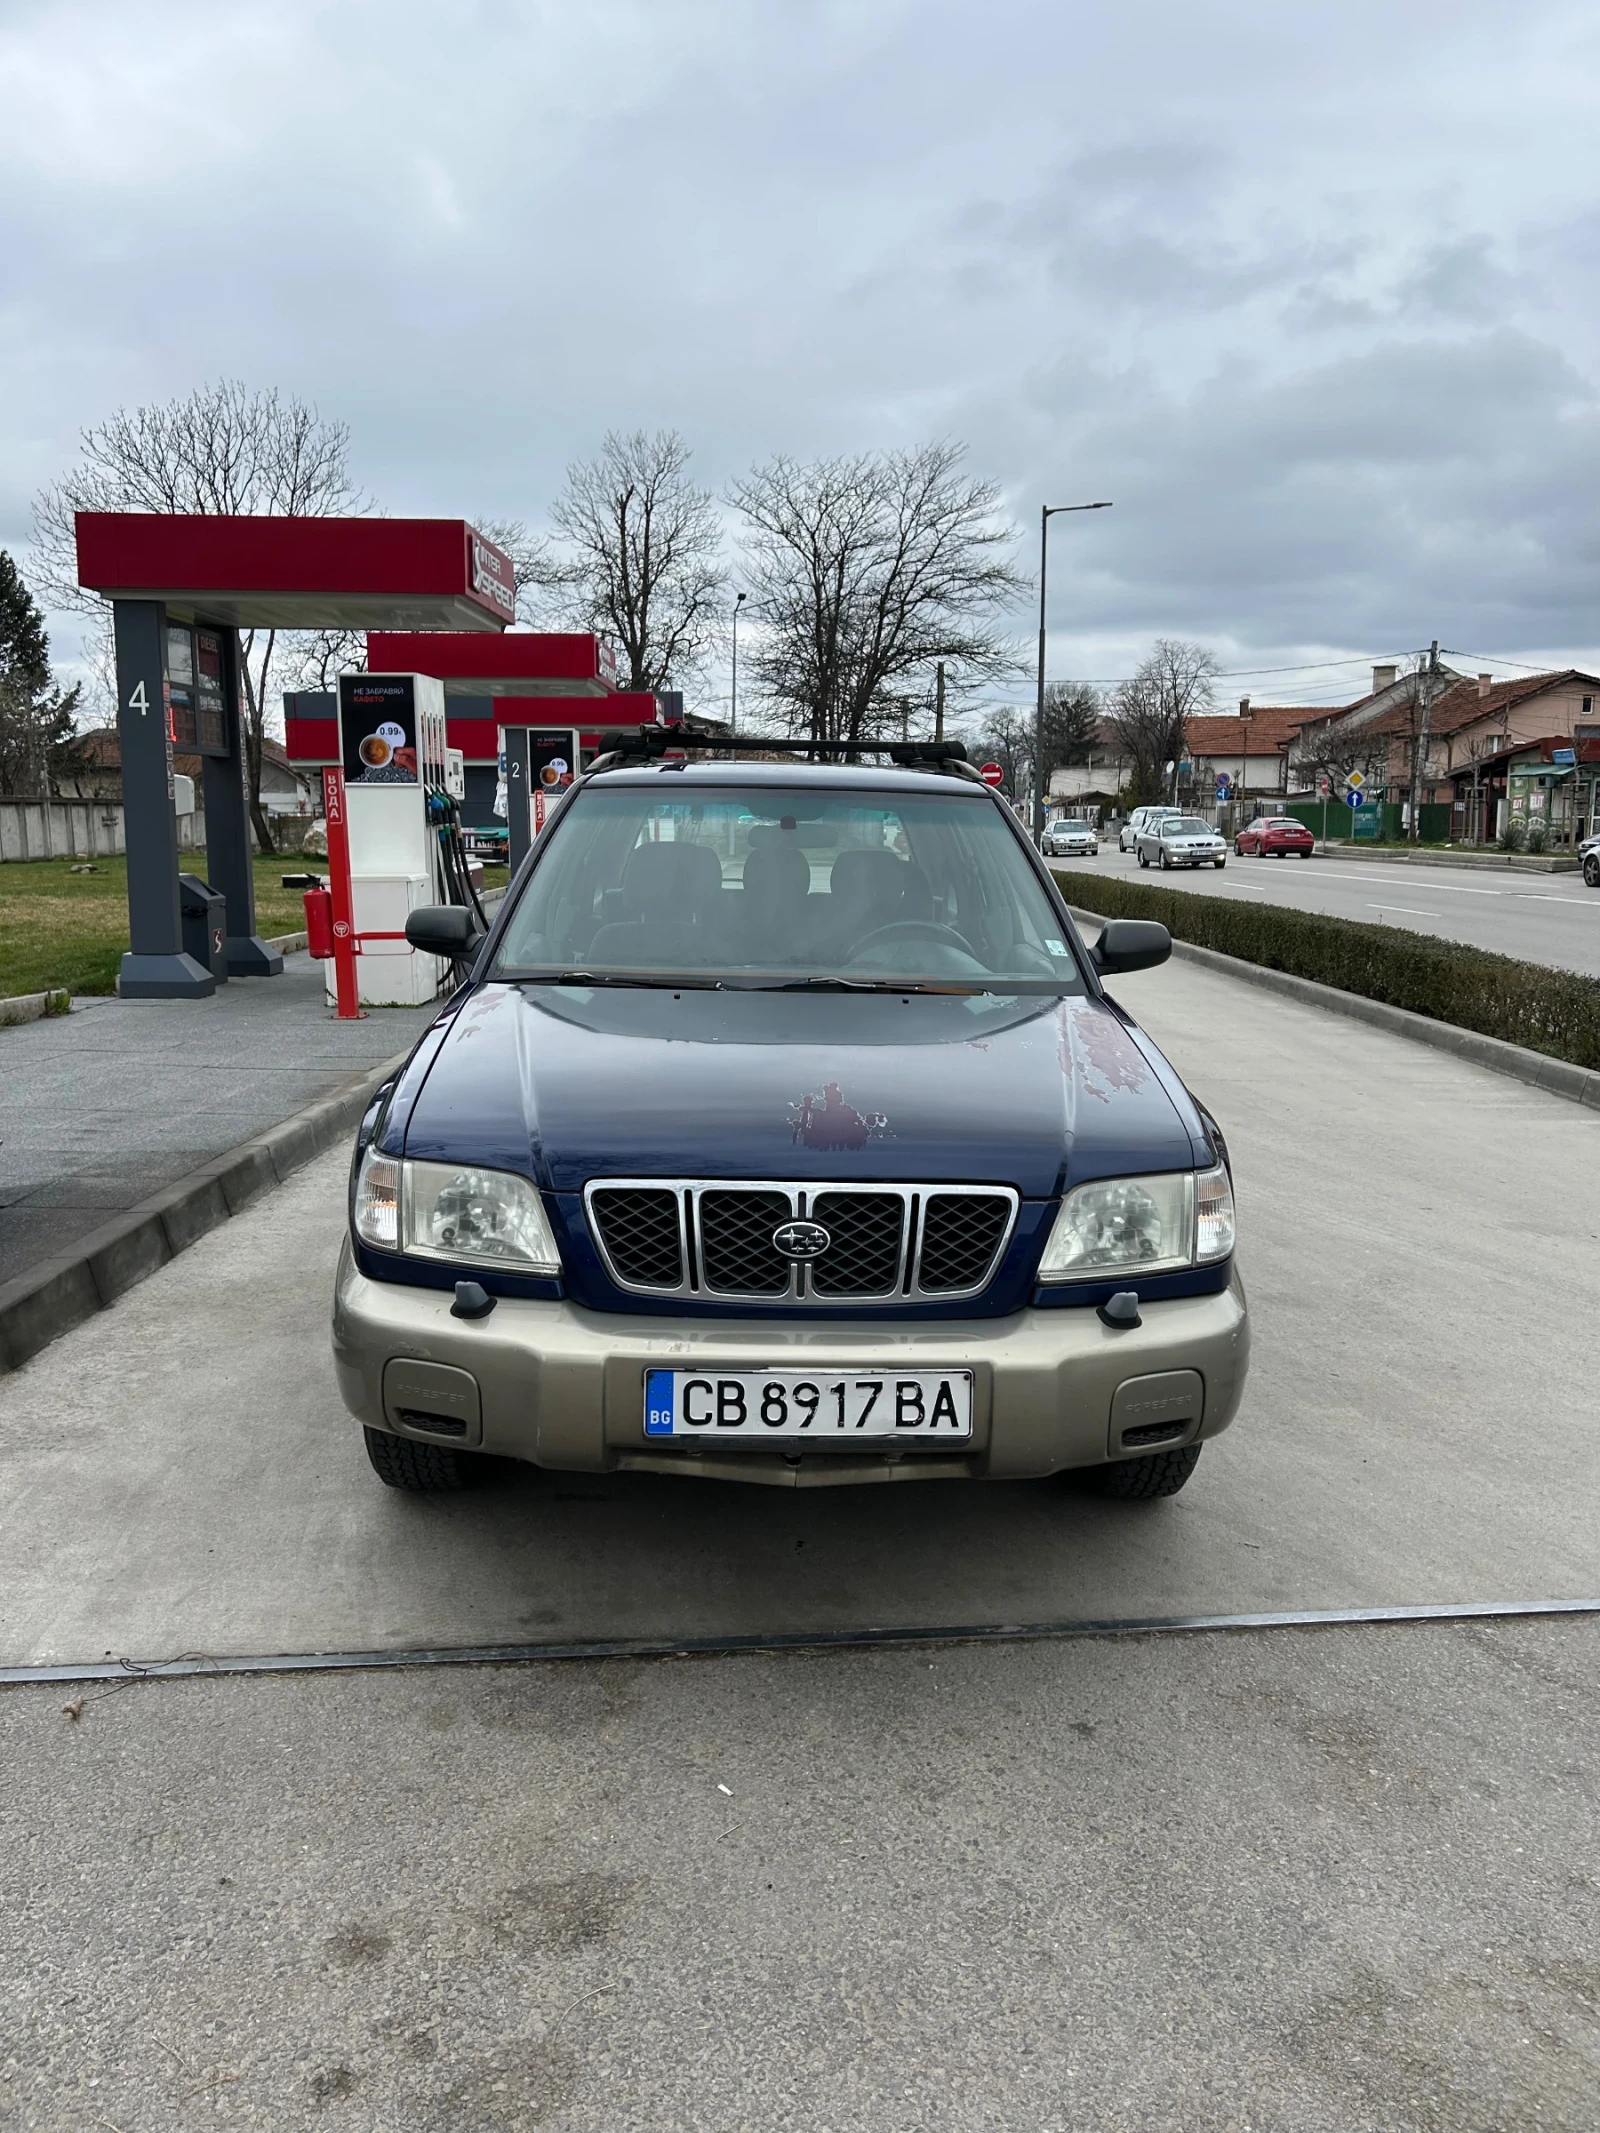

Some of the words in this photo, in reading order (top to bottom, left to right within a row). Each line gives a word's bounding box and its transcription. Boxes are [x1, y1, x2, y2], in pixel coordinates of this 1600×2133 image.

[481, 570, 514, 613] SPEED
[200, 635, 218, 653] DIESEL
[128, 680, 150, 716] 4
[353, 687, 364, 695] НЕ
[365, 686, 404, 695] ЗАБРАВЯЙ
[353, 695, 385, 703] КАФЕТО
[511, 762, 520, 778] 2
[327, 774, 339, 818] ВОДА
[682, 1379, 747, 1427] CB
[760, 1380, 884, 1428] 8917
[895, 1380, 959, 1428] BA
[649, 1410, 671, 1425] BG
